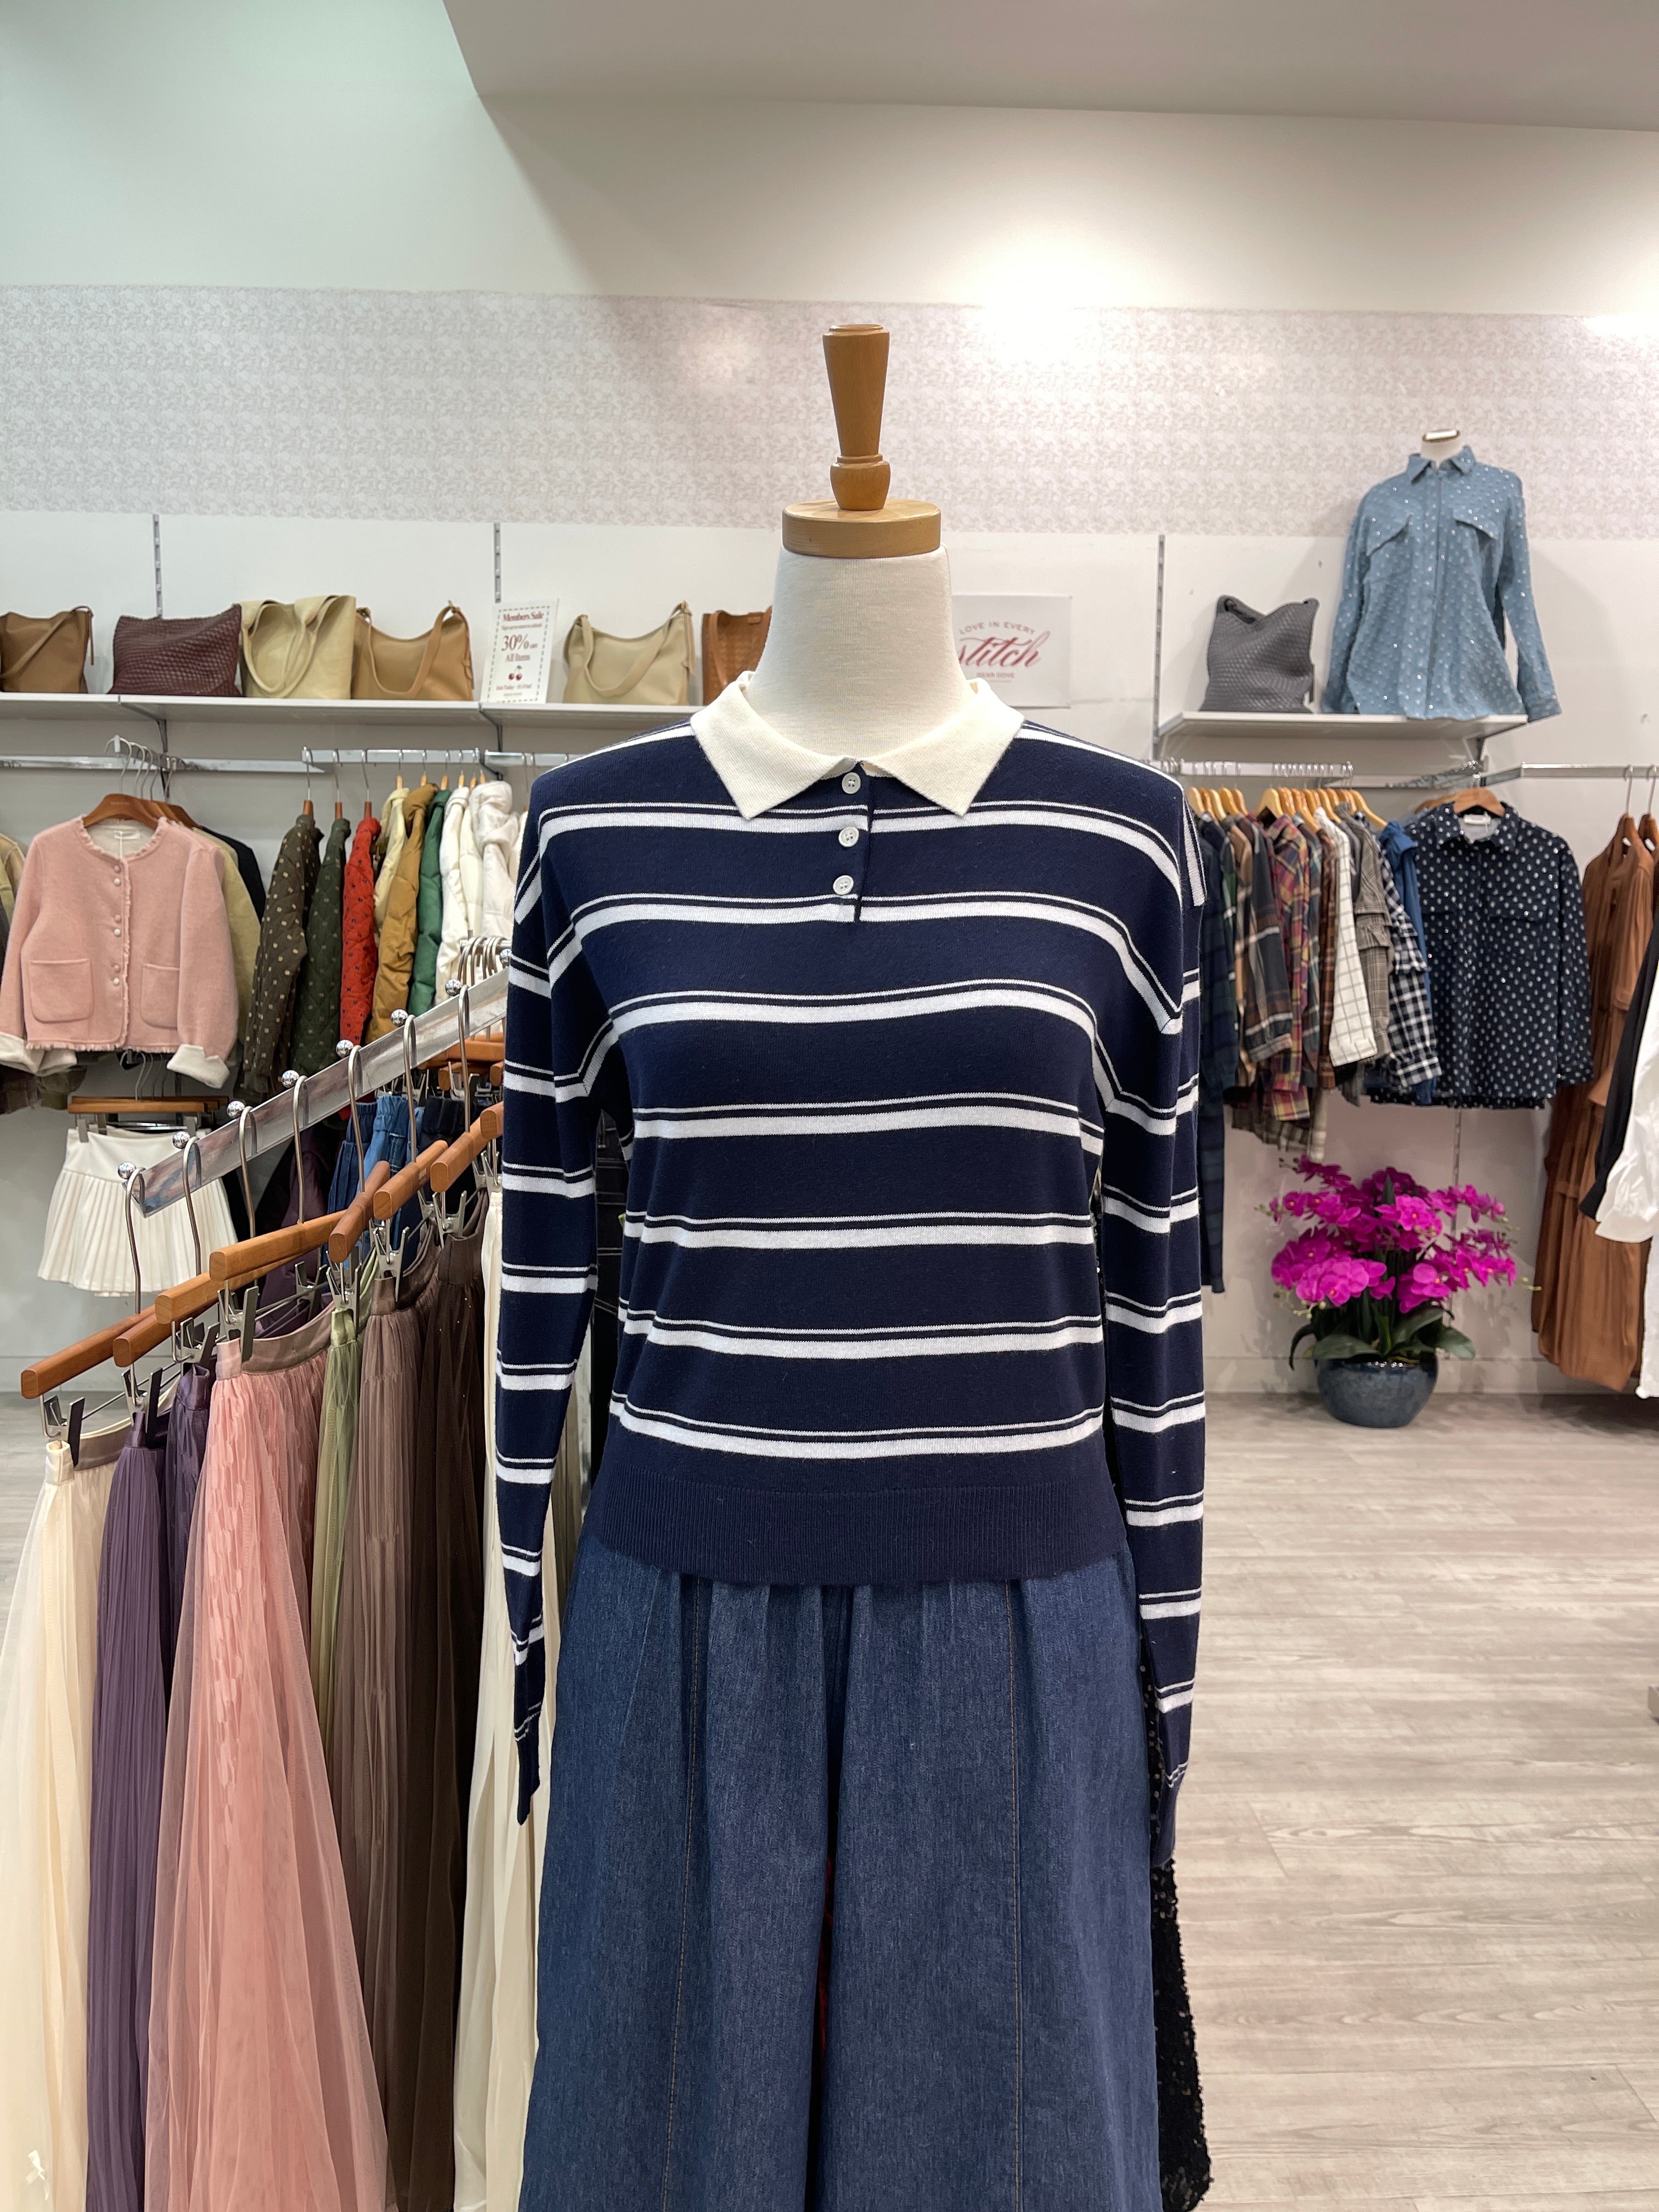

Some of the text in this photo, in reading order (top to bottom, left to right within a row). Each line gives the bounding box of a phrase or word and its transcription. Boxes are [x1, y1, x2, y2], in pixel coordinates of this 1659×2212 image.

[503, 612, 530, 621] Members
[958, 622, 985, 635] LOVE
[1003, 621, 1036, 635] EVERY
[501, 634, 529, 651] 30%
